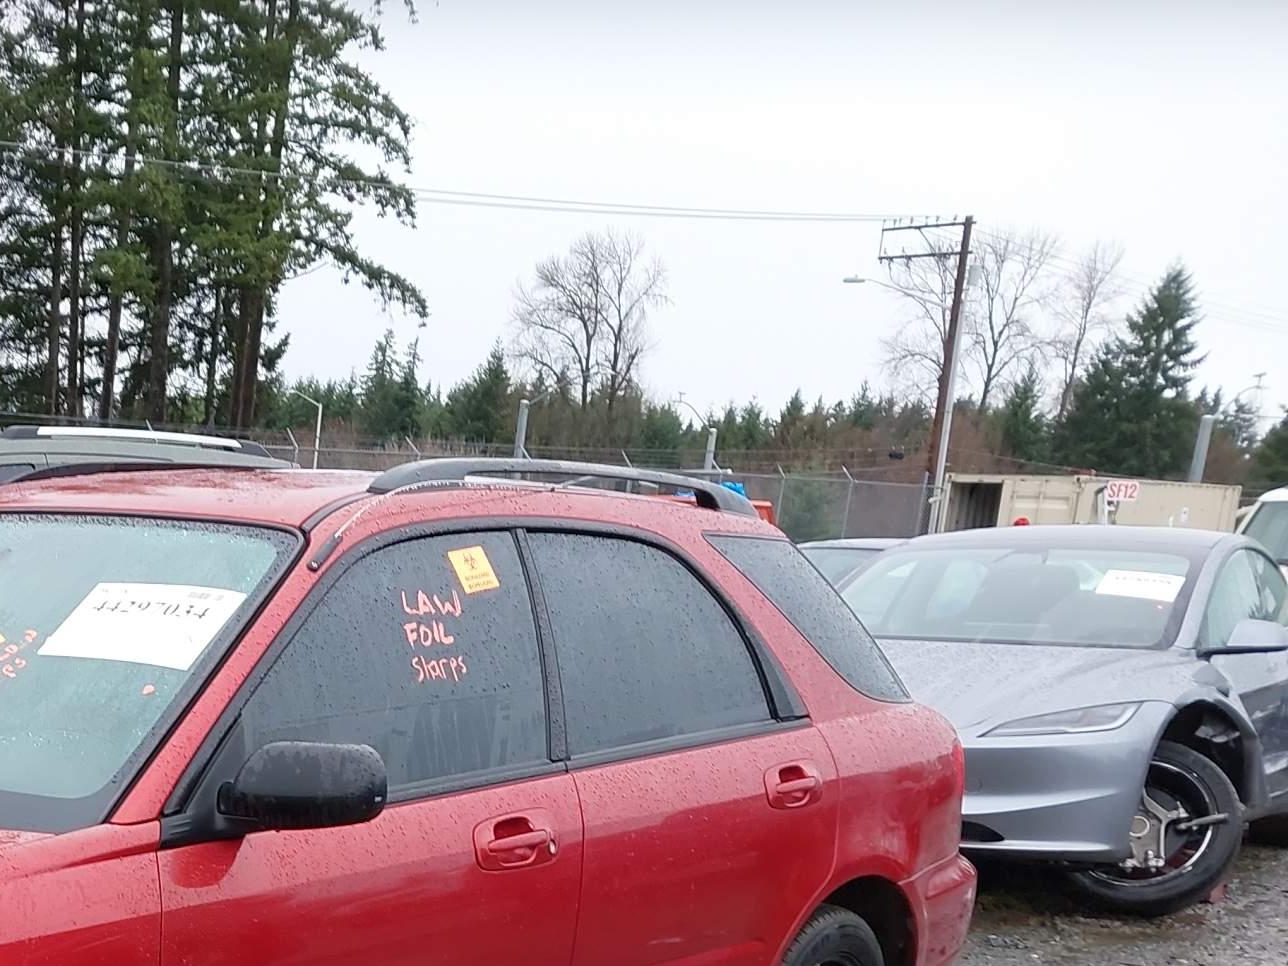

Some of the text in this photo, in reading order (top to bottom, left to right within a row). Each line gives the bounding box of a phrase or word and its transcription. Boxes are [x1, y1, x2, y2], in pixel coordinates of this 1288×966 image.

[1108, 483, 1138, 499] SF12
[401, 589, 462, 617] LAW
[403, 620, 455, 650] FOIL
